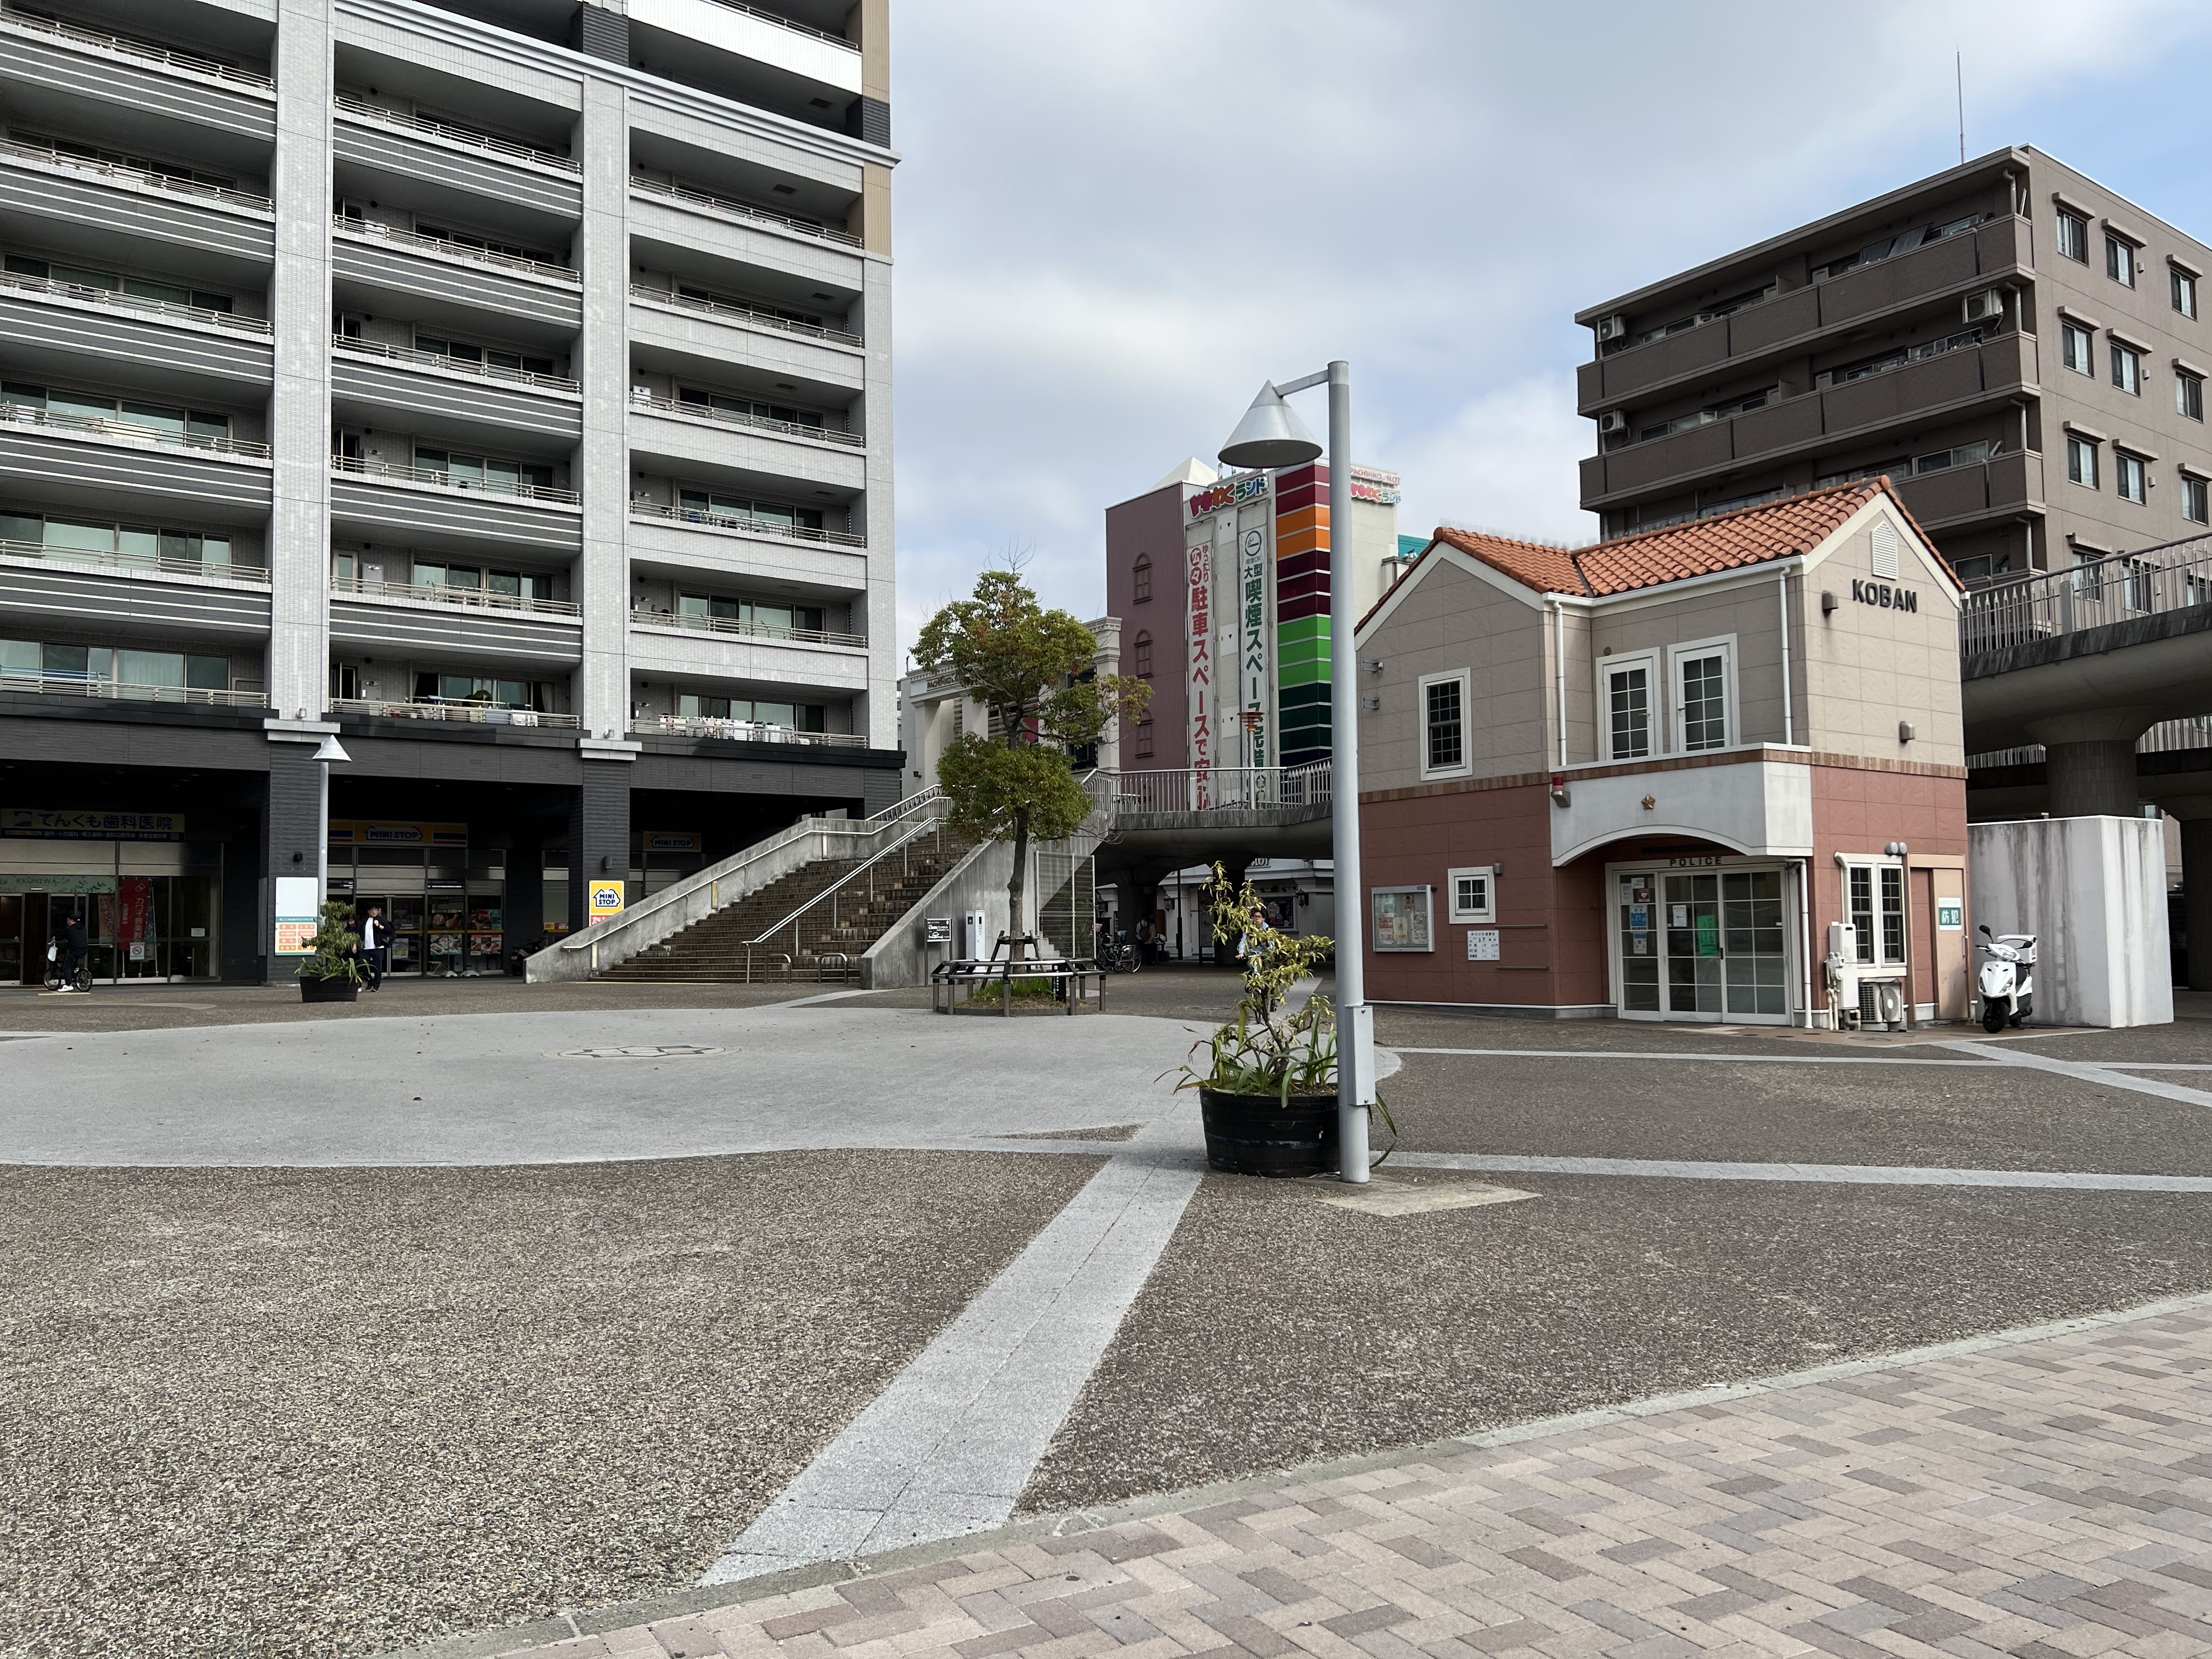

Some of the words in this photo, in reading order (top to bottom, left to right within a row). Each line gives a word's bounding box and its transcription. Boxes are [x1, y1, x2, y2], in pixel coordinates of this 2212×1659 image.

[1350, 467, 1382, 479] PACHINKO
[1190, 548, 1202, 585] 広々
[1202, 543, 1210, 583] ゆったり
[1244, 562, 1263, 579] 大型
[1852, 578, 1917, 613] KOBAN
[38, 813, 173, 830] てんくも歯科医院
[370, 830, 392, 838] MINI
[1669, 856, 1722, 867] POLICE
[1941, 909, 1960, 924] 防犯
